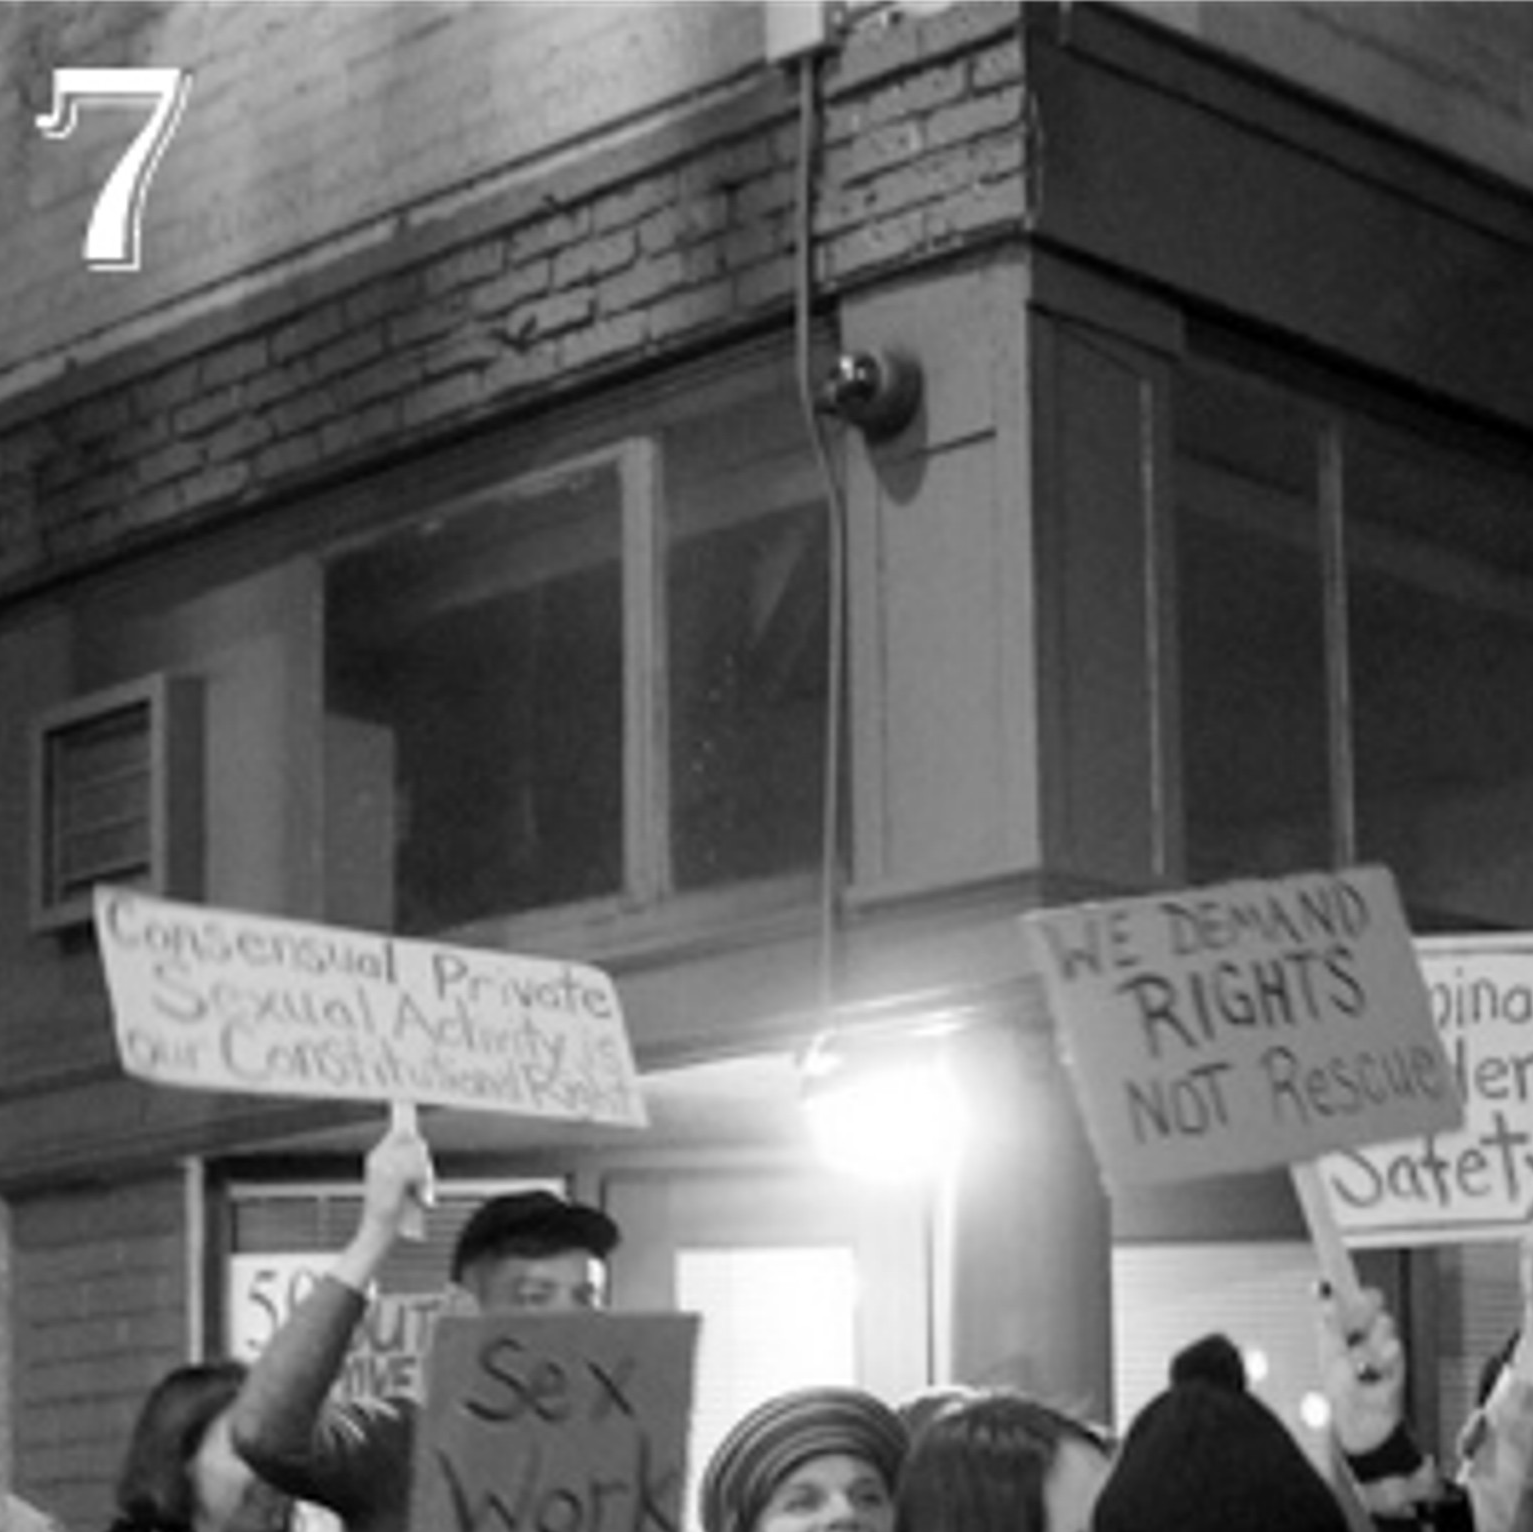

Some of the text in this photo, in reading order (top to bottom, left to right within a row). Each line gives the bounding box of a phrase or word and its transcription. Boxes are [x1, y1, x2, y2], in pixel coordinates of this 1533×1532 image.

[106, 895, 613, 1019] Consensual Private
[1045, 881, 1368, 980] WE DEMAND
[150, 963, 377, 1033] Sexual
[1116, 945, 1367, 1058] RIGHTS
[1124, 1046, 1446, 1144] NOT Rescue
[467, 1337, 636, 1422] Sex
